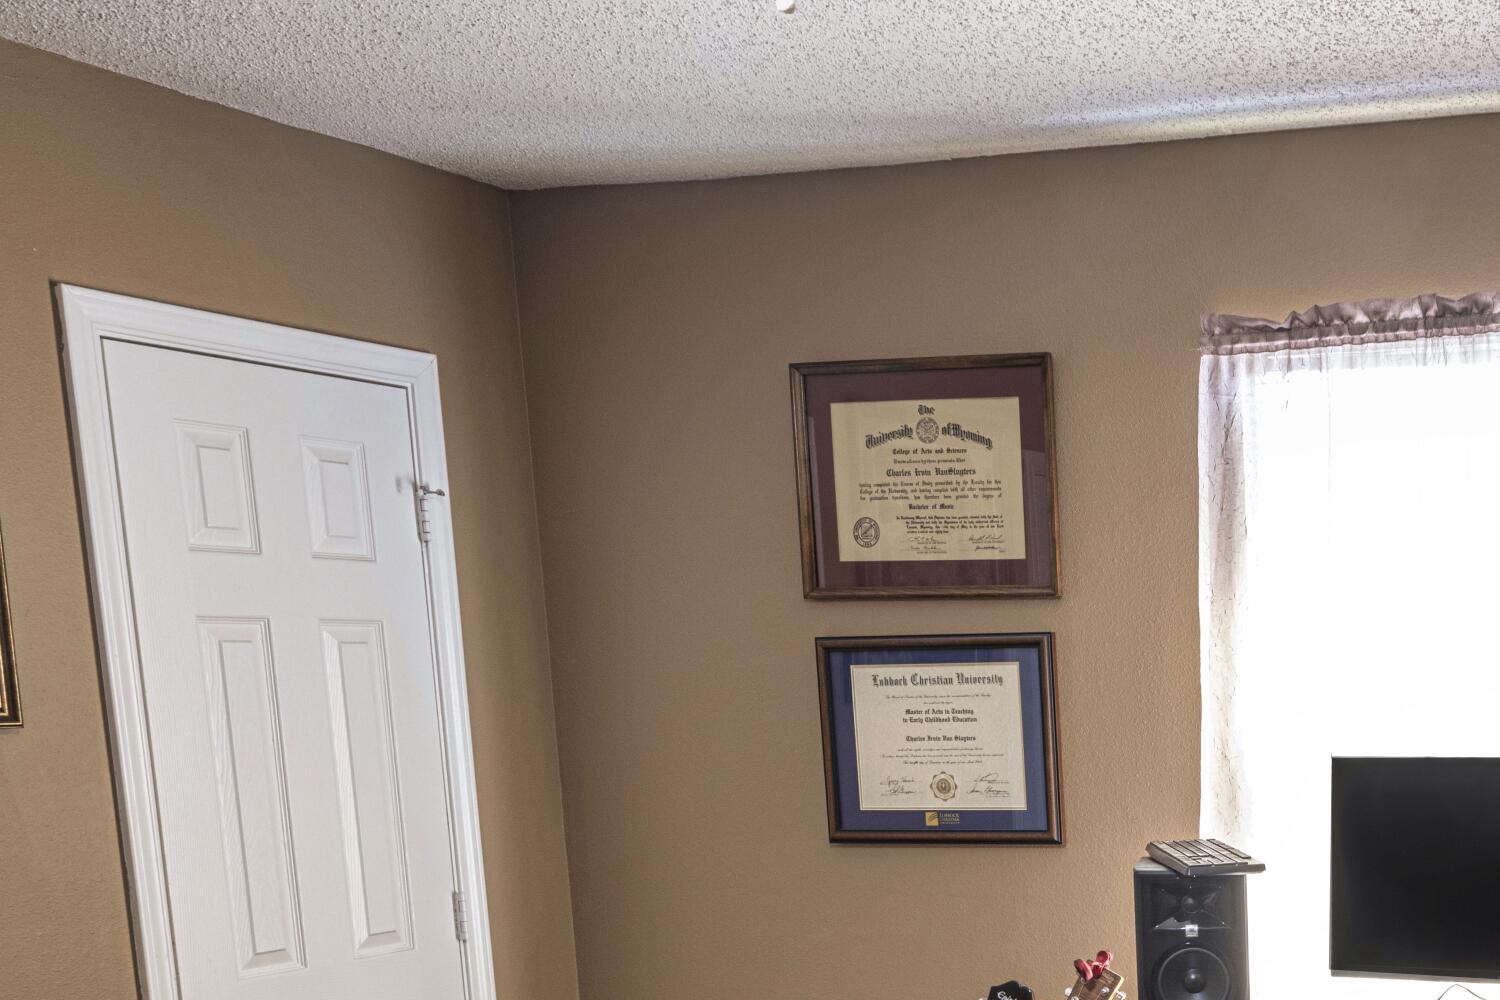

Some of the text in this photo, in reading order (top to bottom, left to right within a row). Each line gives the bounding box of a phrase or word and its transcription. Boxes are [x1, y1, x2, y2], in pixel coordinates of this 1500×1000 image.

[918, 404, 935, 415] The
[865, 424, 914, 449] University
[886, 468, 911, 477] Charles
[872, 672, 1004, 687] Lubbock Christian University
